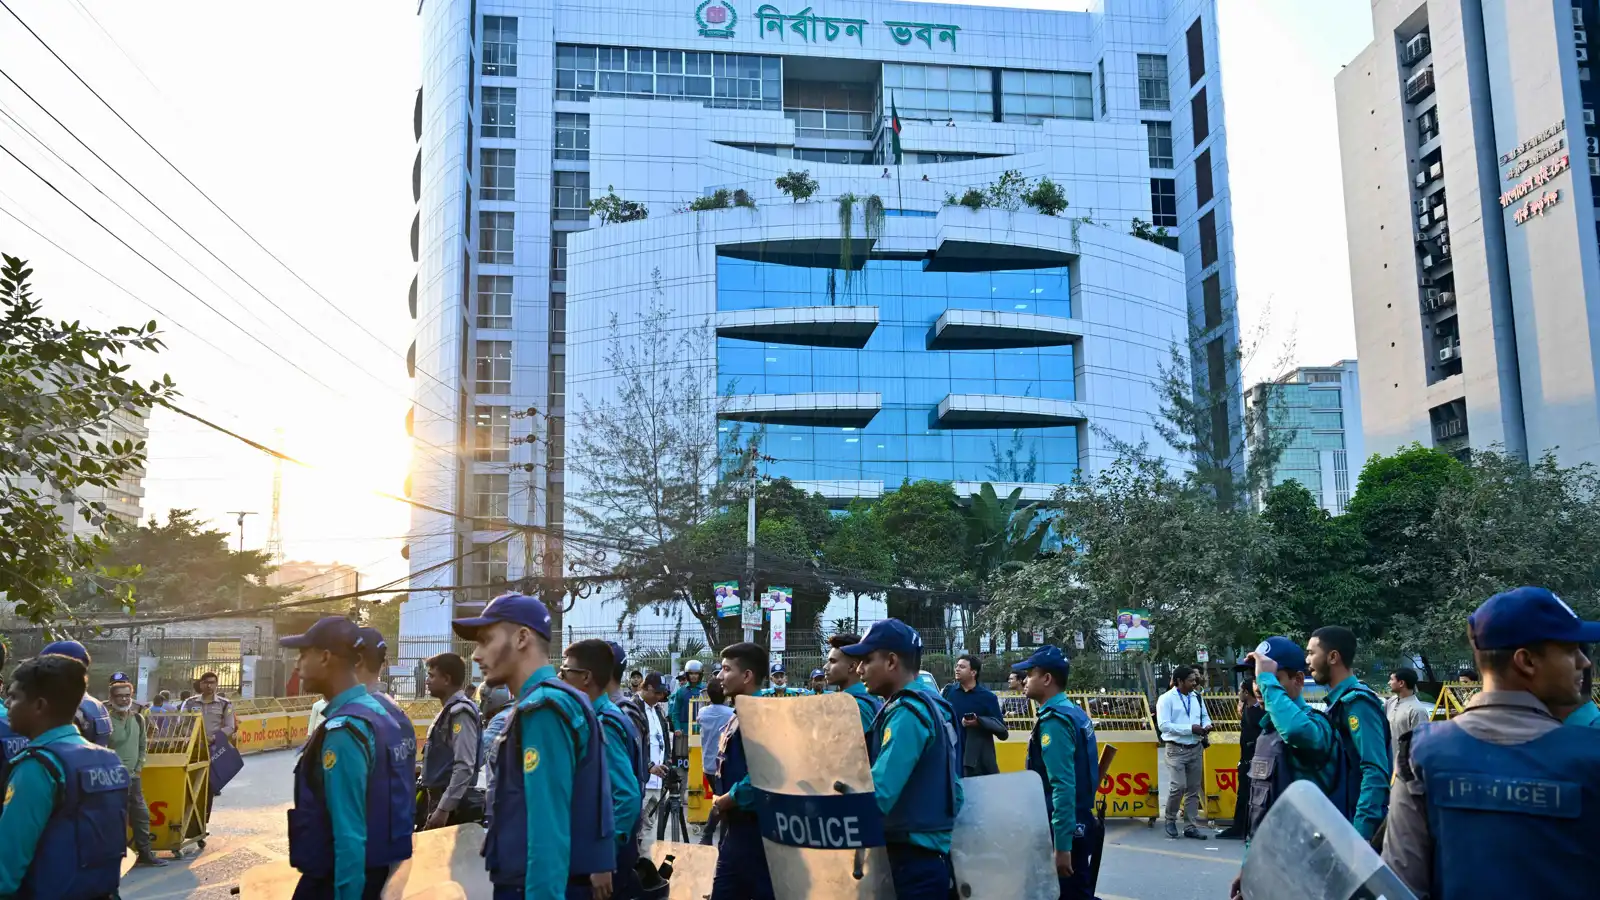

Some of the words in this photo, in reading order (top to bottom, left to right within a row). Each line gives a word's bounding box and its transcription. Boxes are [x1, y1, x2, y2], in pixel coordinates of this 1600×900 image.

[753, 4, 869, 46] নির্বাচন
[883, 20, 961, 52] ভবন
[242, 731, 251, 744] Do
[254, 728, 266, 741] not
[88, 767, 126, 786] POLICE
[775, 812, 862, 848] POLICE
